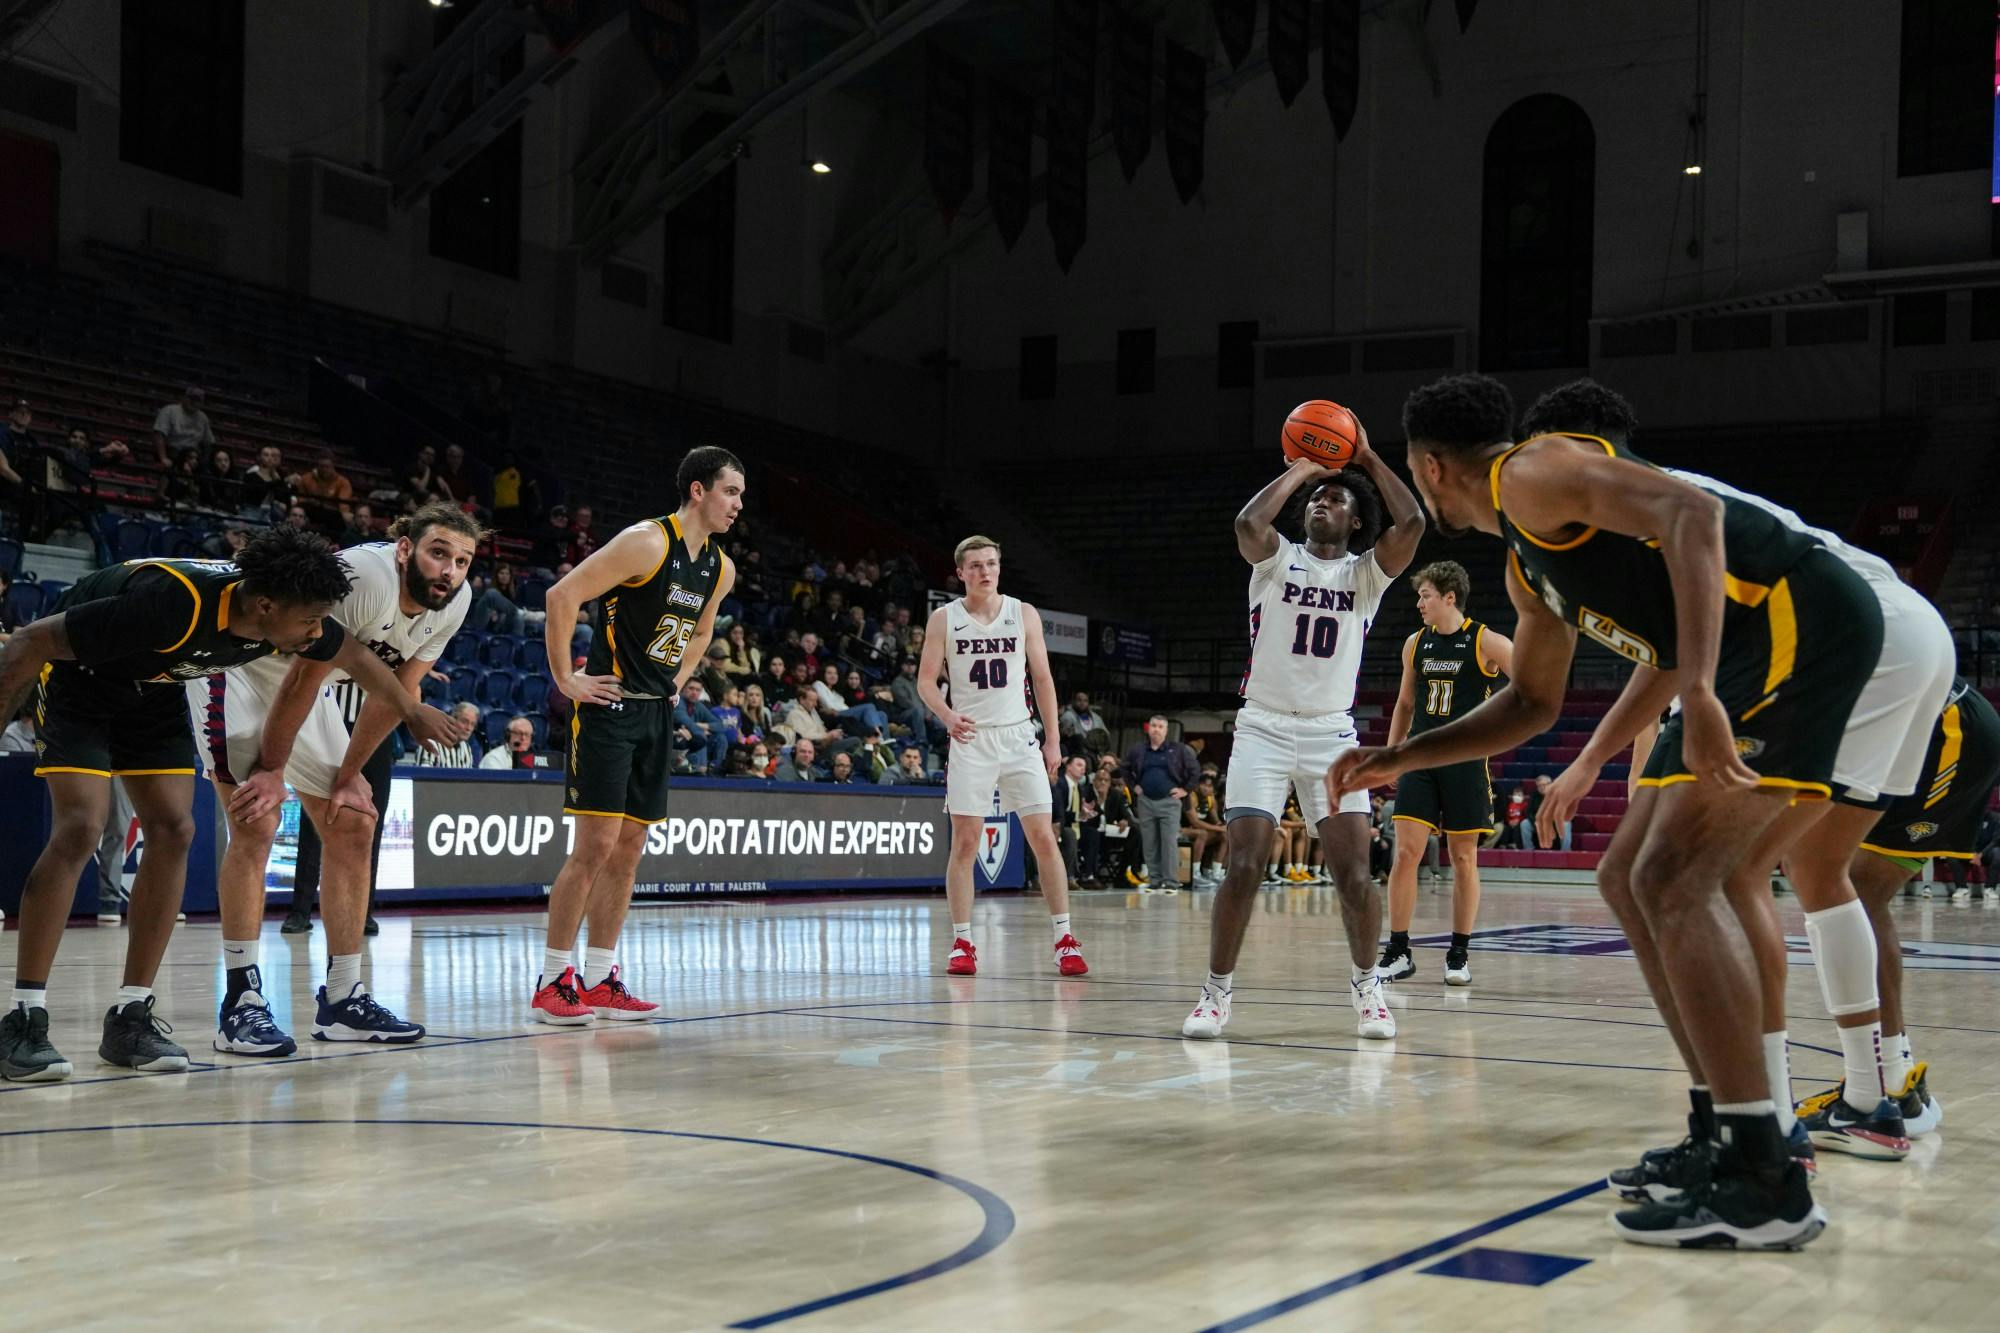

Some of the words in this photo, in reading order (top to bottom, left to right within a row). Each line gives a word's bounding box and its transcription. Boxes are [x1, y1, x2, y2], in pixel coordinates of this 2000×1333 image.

[667, 582, 704, 613] TOWSON
[1282, 582, 1356, 612] PENN
[646, 613, 697, 667] 25
[956, 637, 1018, 655] PENN
[1291, 613, 1339, 659] 10
[969, 658, 1008, 690] 40
[1422, 658, 1464, 675] TOWSON
[1426, 680, 1454, 716] 11
[427, 813, 554, 857] GROUP
[562, 816, 825, 856] TSPORTATION
[829, 821, 934, 854] EXPERTS
[663, 884, 691, 893] COURT
[695, 884, 705, 892] AT
[709, 883, 725, 892] THE
[728, 882, 767, 891] PALESTRA
